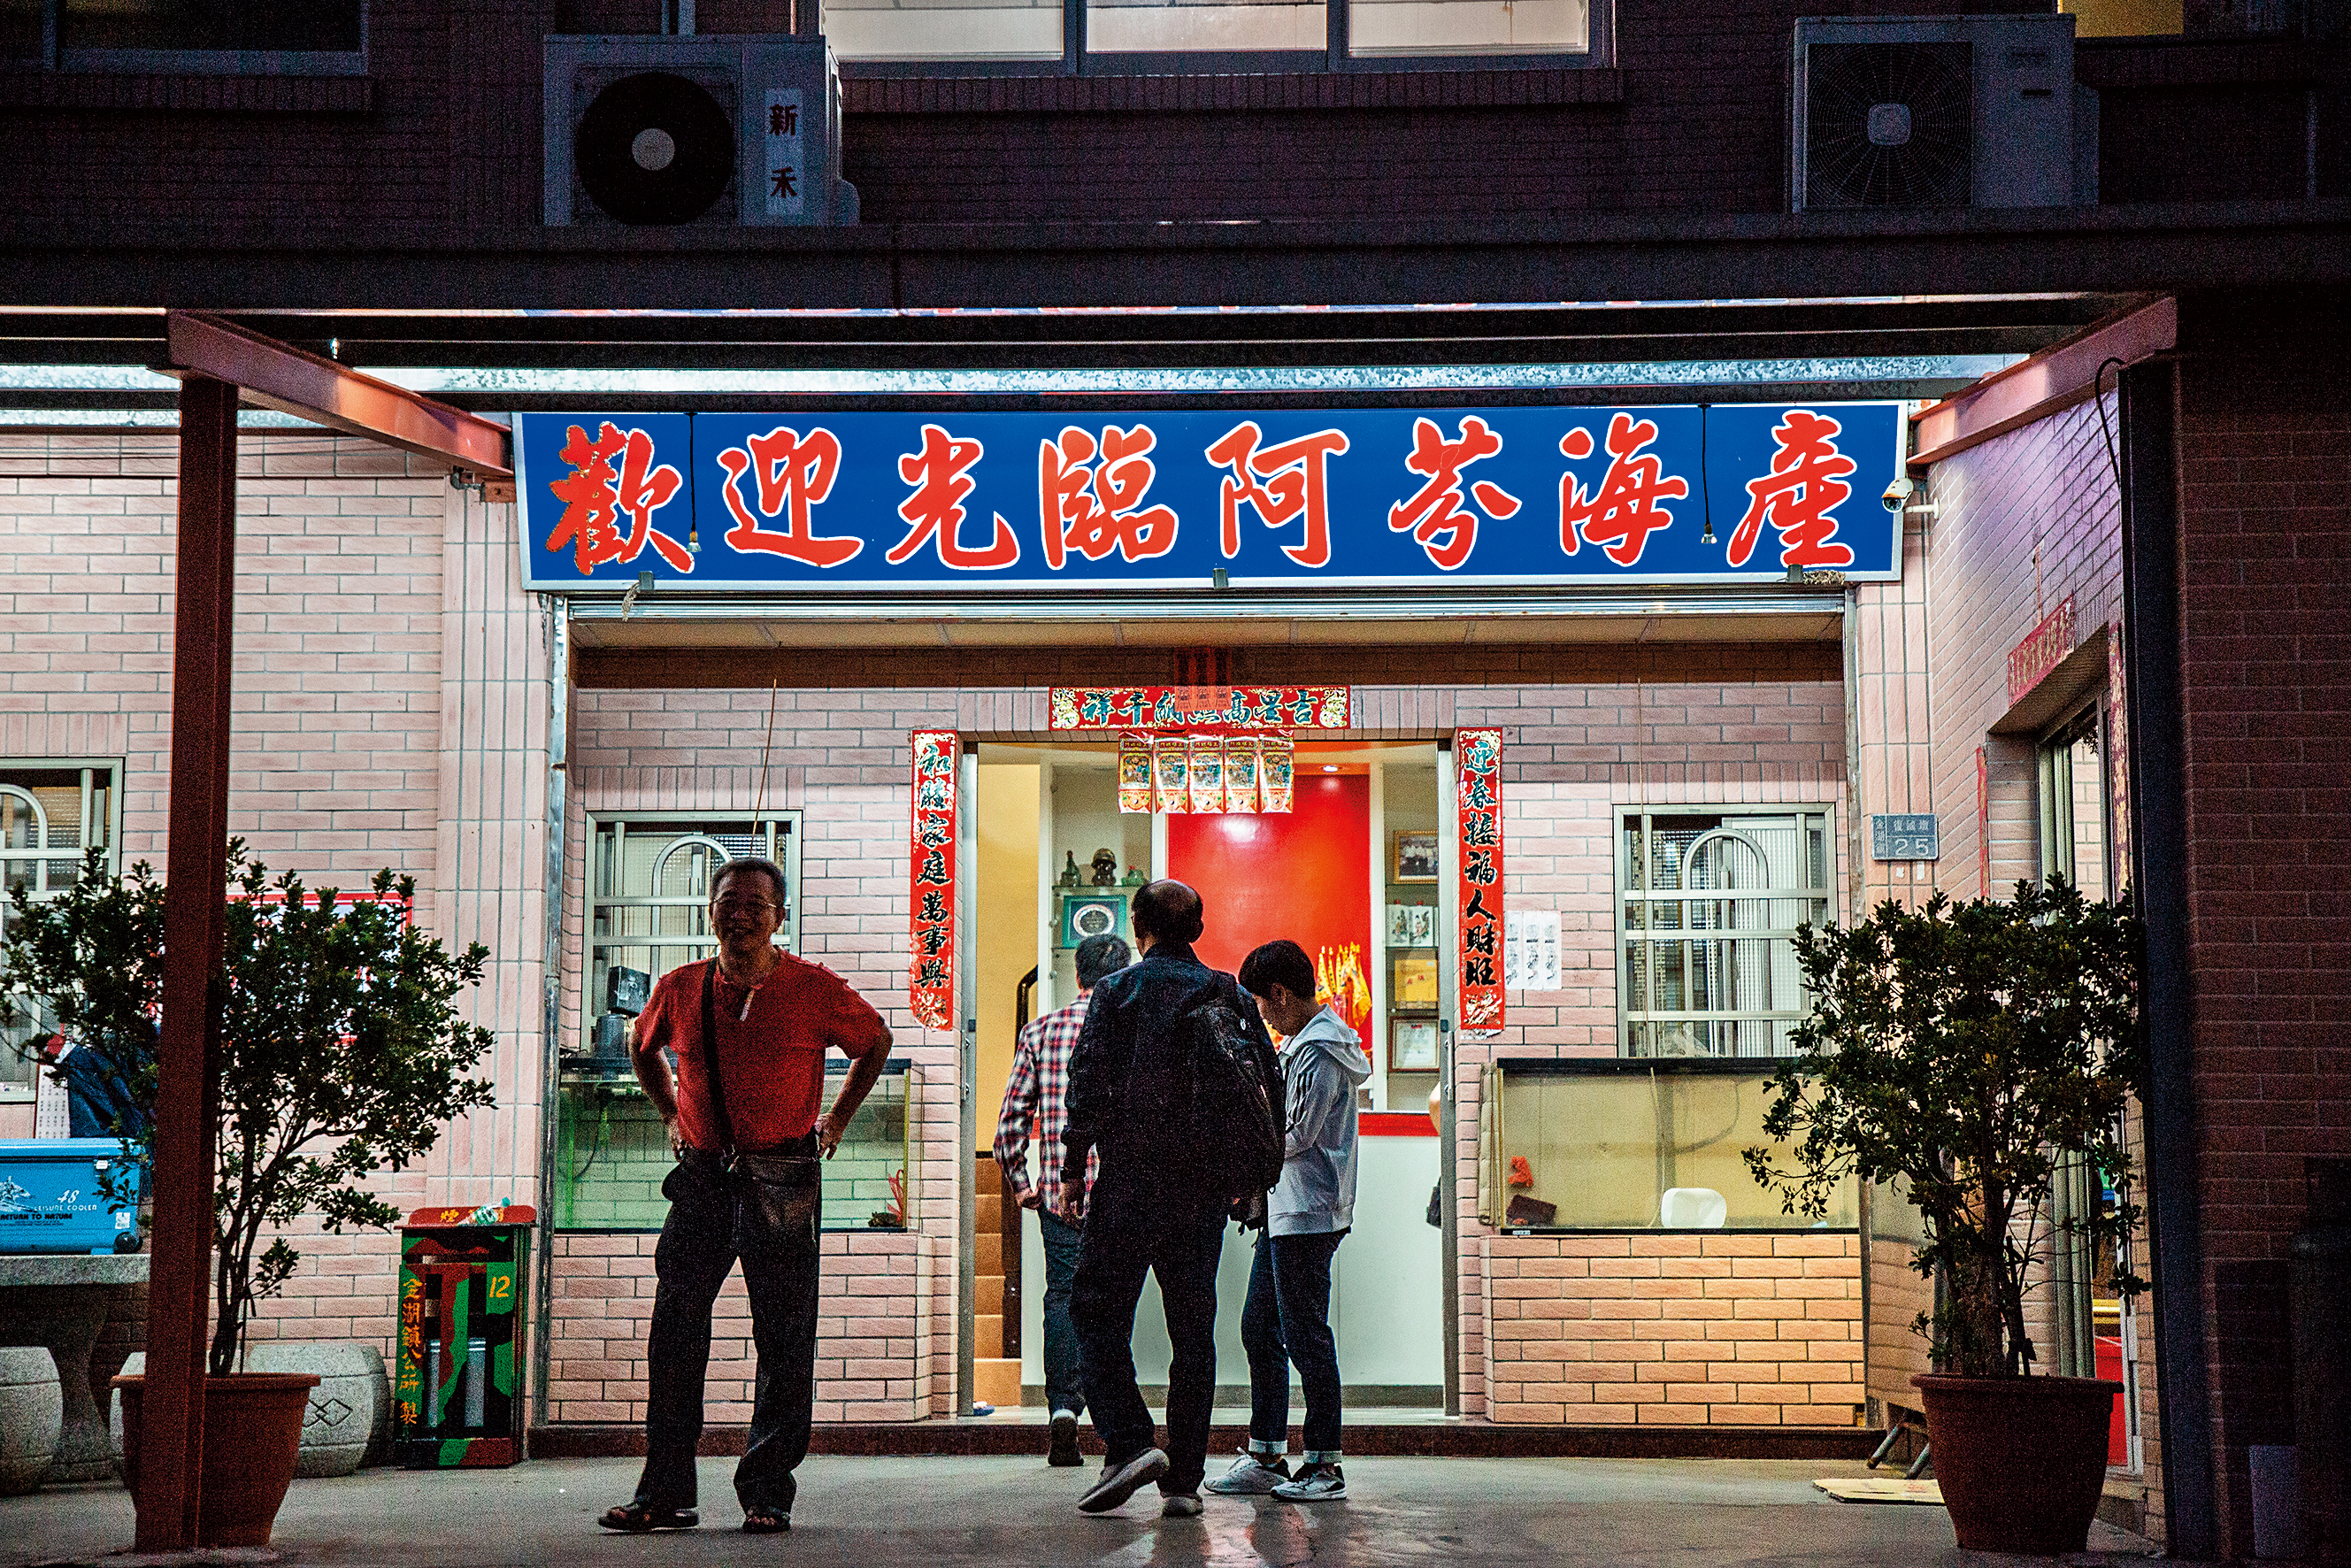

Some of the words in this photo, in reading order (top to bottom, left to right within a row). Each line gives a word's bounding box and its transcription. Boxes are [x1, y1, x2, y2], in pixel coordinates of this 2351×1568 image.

[769, 104, 798, 198] 新禾
[545, 410, 1857, 575] 歡迎光臨阿芬海產
[1464, 741, 1498, 988] 迎春接福人財旺
[1894, 838, 1929, 856] 25
[489, 1275, 511, 1298] 12
